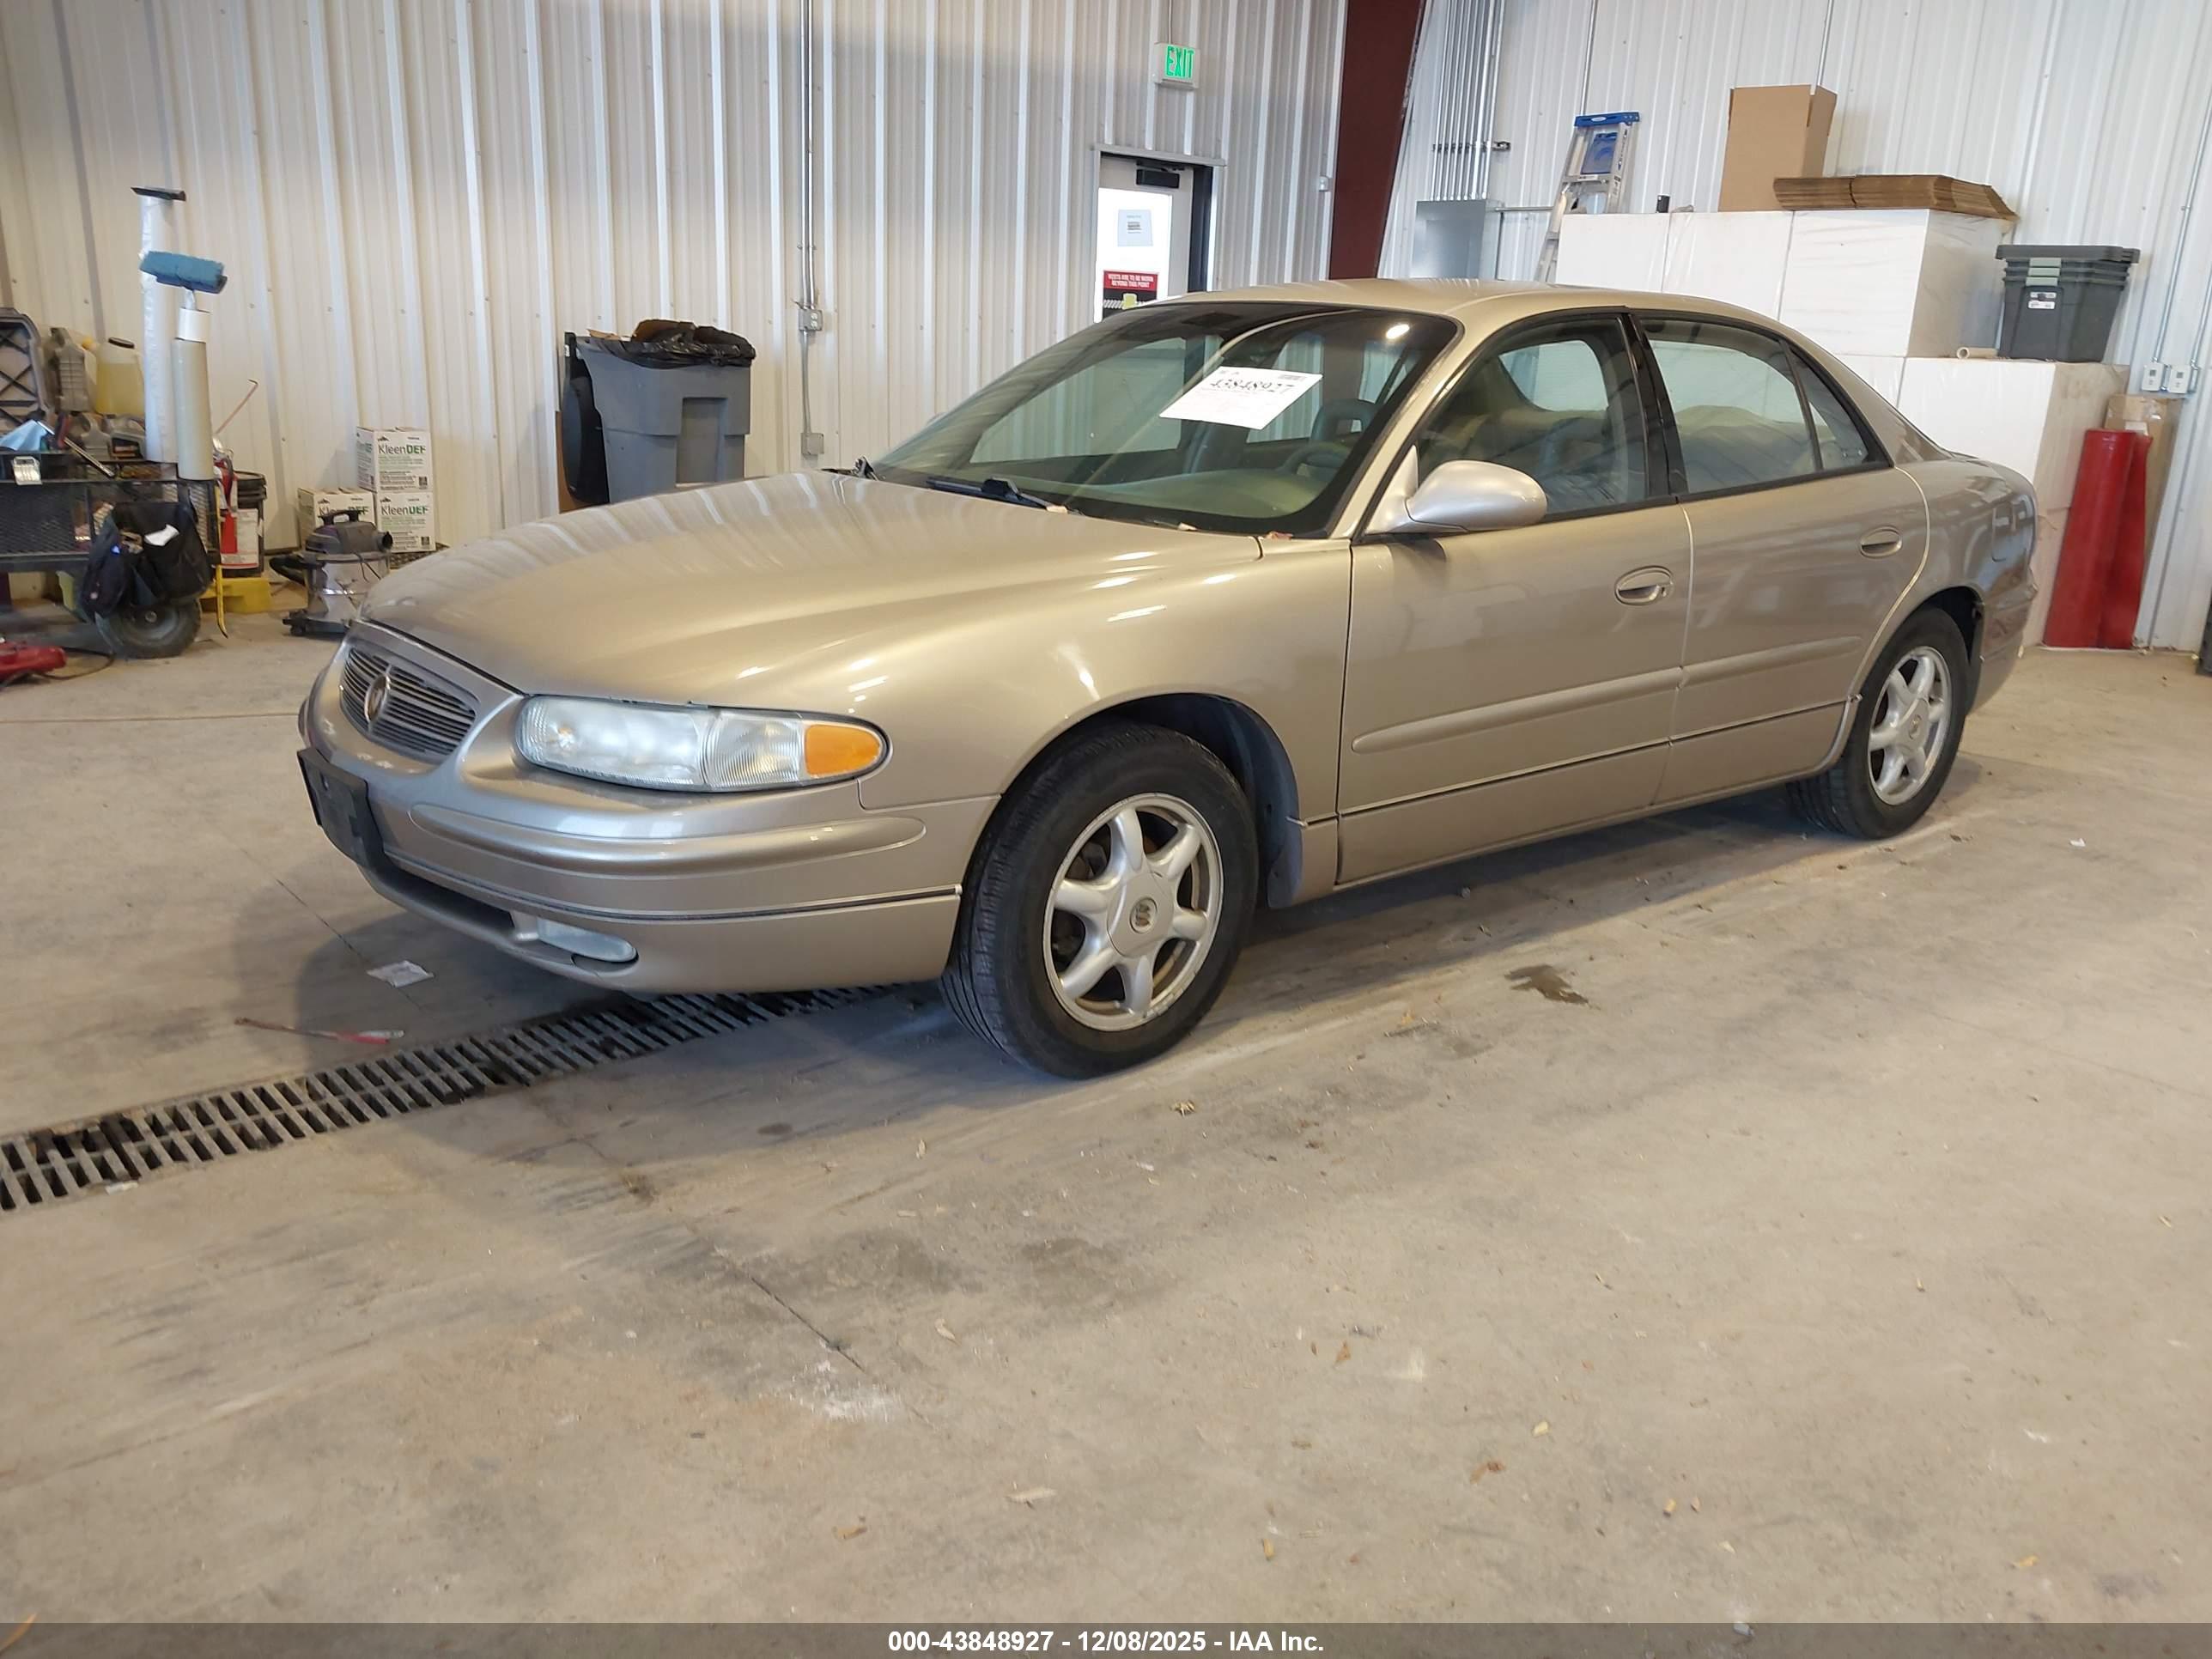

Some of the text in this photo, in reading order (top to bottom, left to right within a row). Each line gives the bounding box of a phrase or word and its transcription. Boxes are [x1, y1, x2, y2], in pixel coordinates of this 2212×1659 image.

[1167, 46, 1194, 78] EXIT
[378, 444, 426, 454] KleenDEF
[381, 505, 428, 515] KleenDEF
